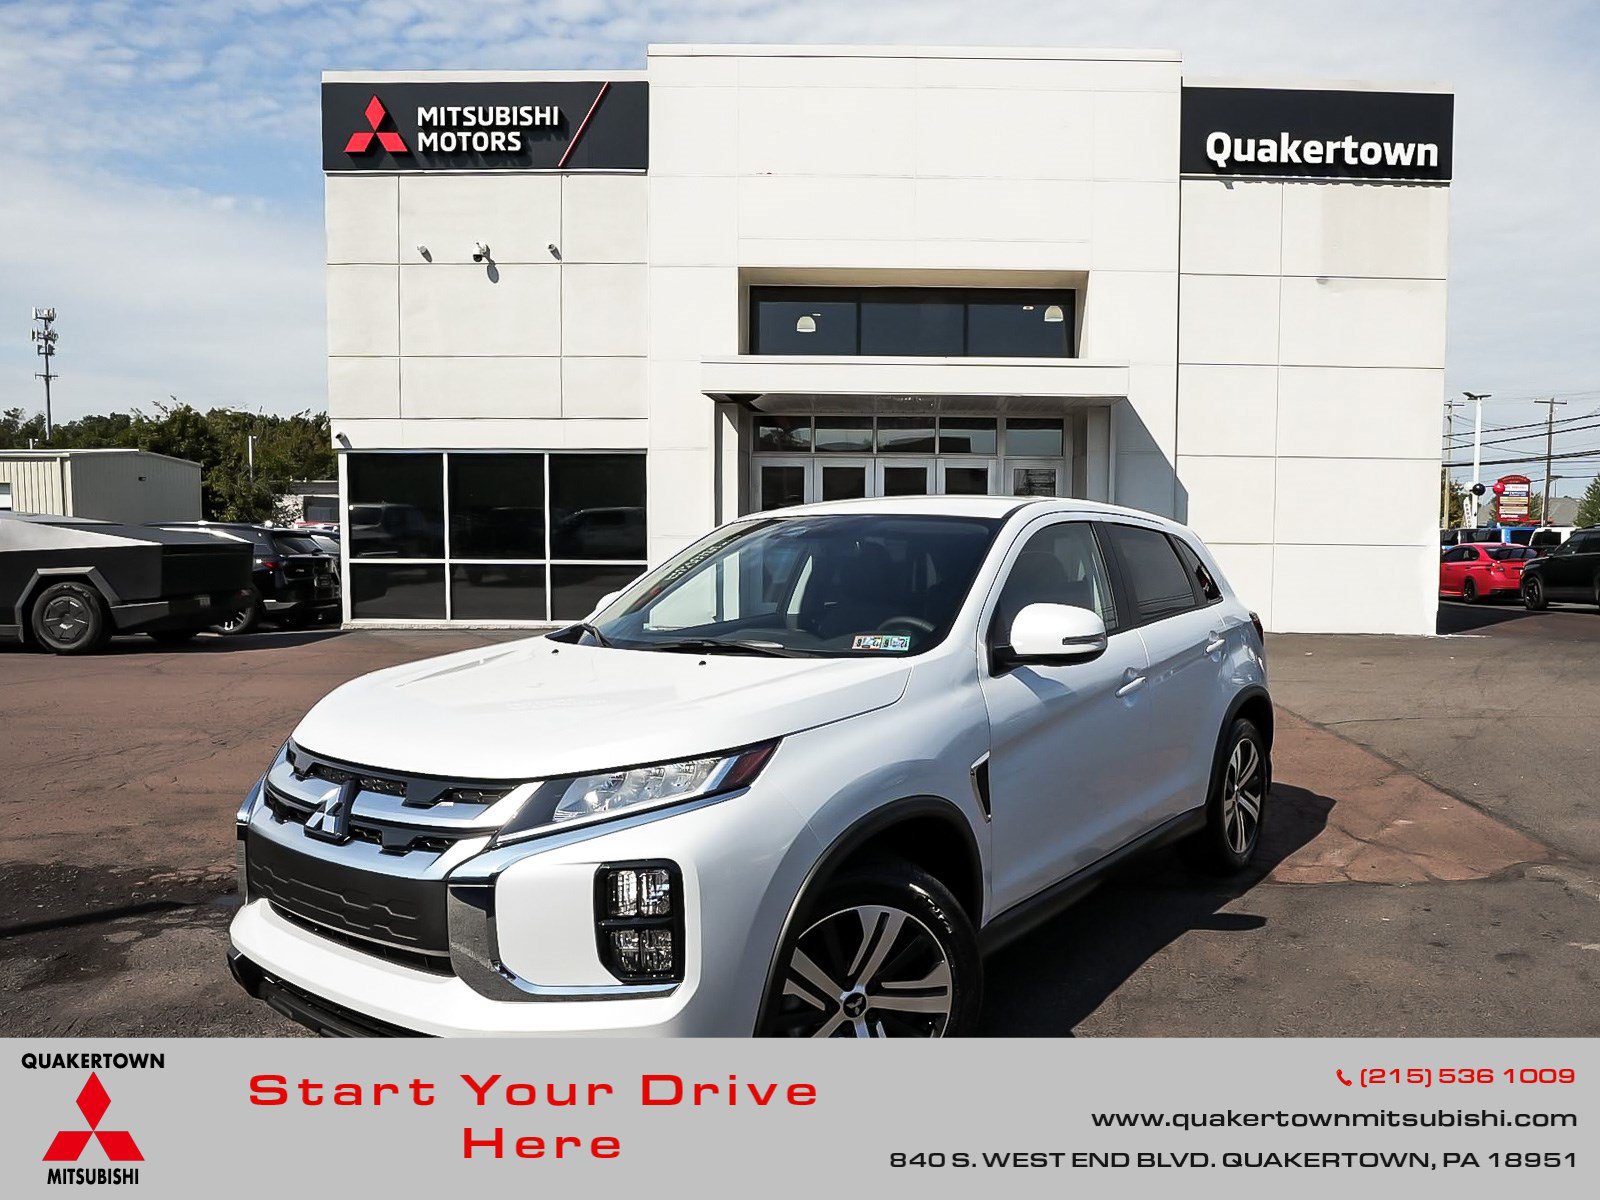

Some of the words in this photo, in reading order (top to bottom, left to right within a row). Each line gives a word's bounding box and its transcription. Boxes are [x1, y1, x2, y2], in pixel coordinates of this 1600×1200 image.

[417, 105, 559, 127] MITSUBISHI
[418, 131, 522, 152] MOTORS
[1206, 131, 1438, 168] Quakertown
